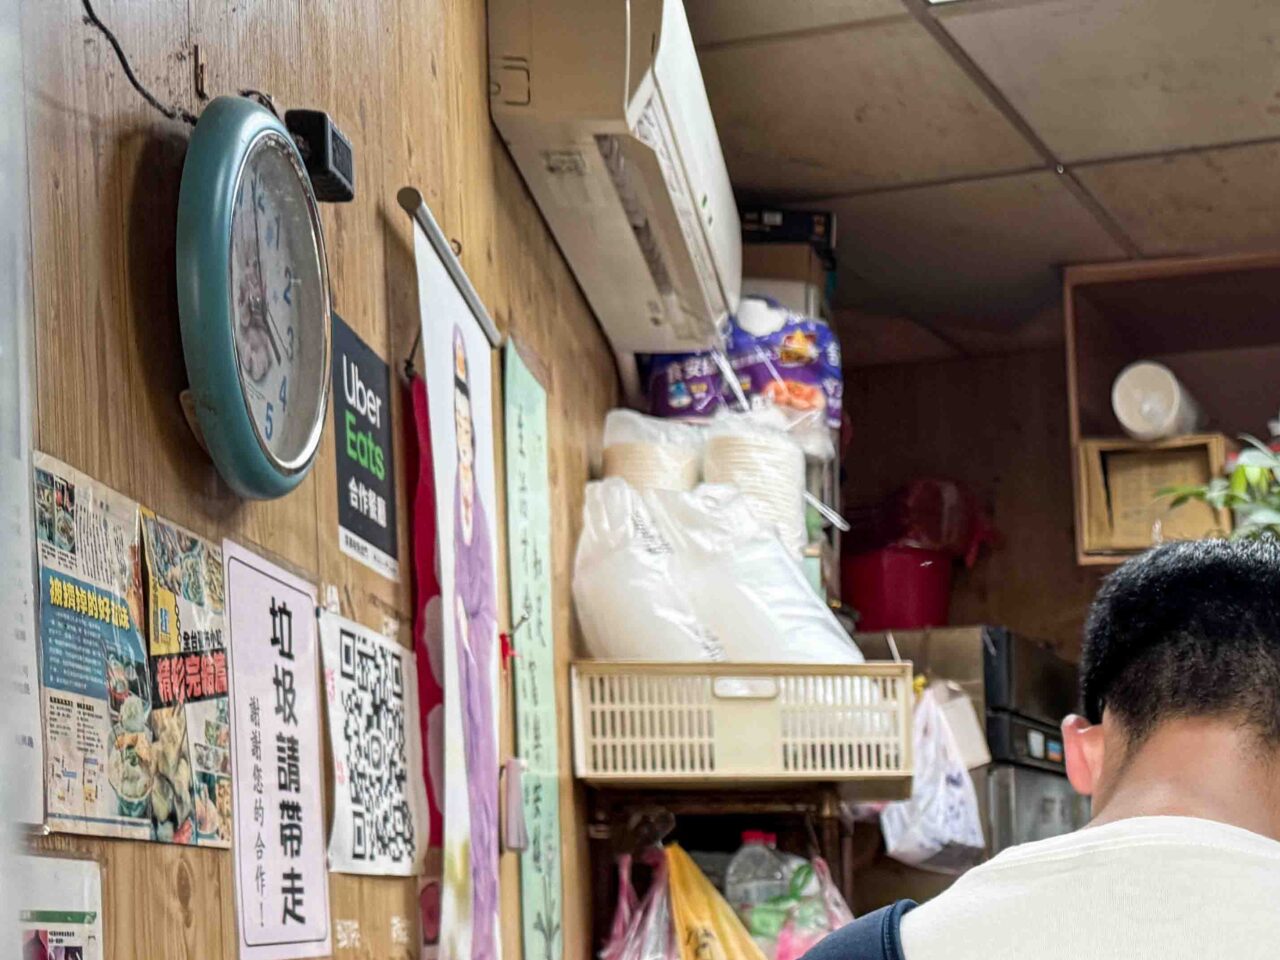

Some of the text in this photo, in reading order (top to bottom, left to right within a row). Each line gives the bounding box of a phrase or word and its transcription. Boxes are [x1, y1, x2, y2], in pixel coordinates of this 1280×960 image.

[283, 265, 293, 305] 2
[286, 325, 294, 361] 3
[278, 374, 288, 413] 4
[342, 353, 382, 429] Uber
[264, 401, 274, 441] 5
[345, 410, 386, 482] Eats
[269, 596, 306, 925] 垃圾請帶走
